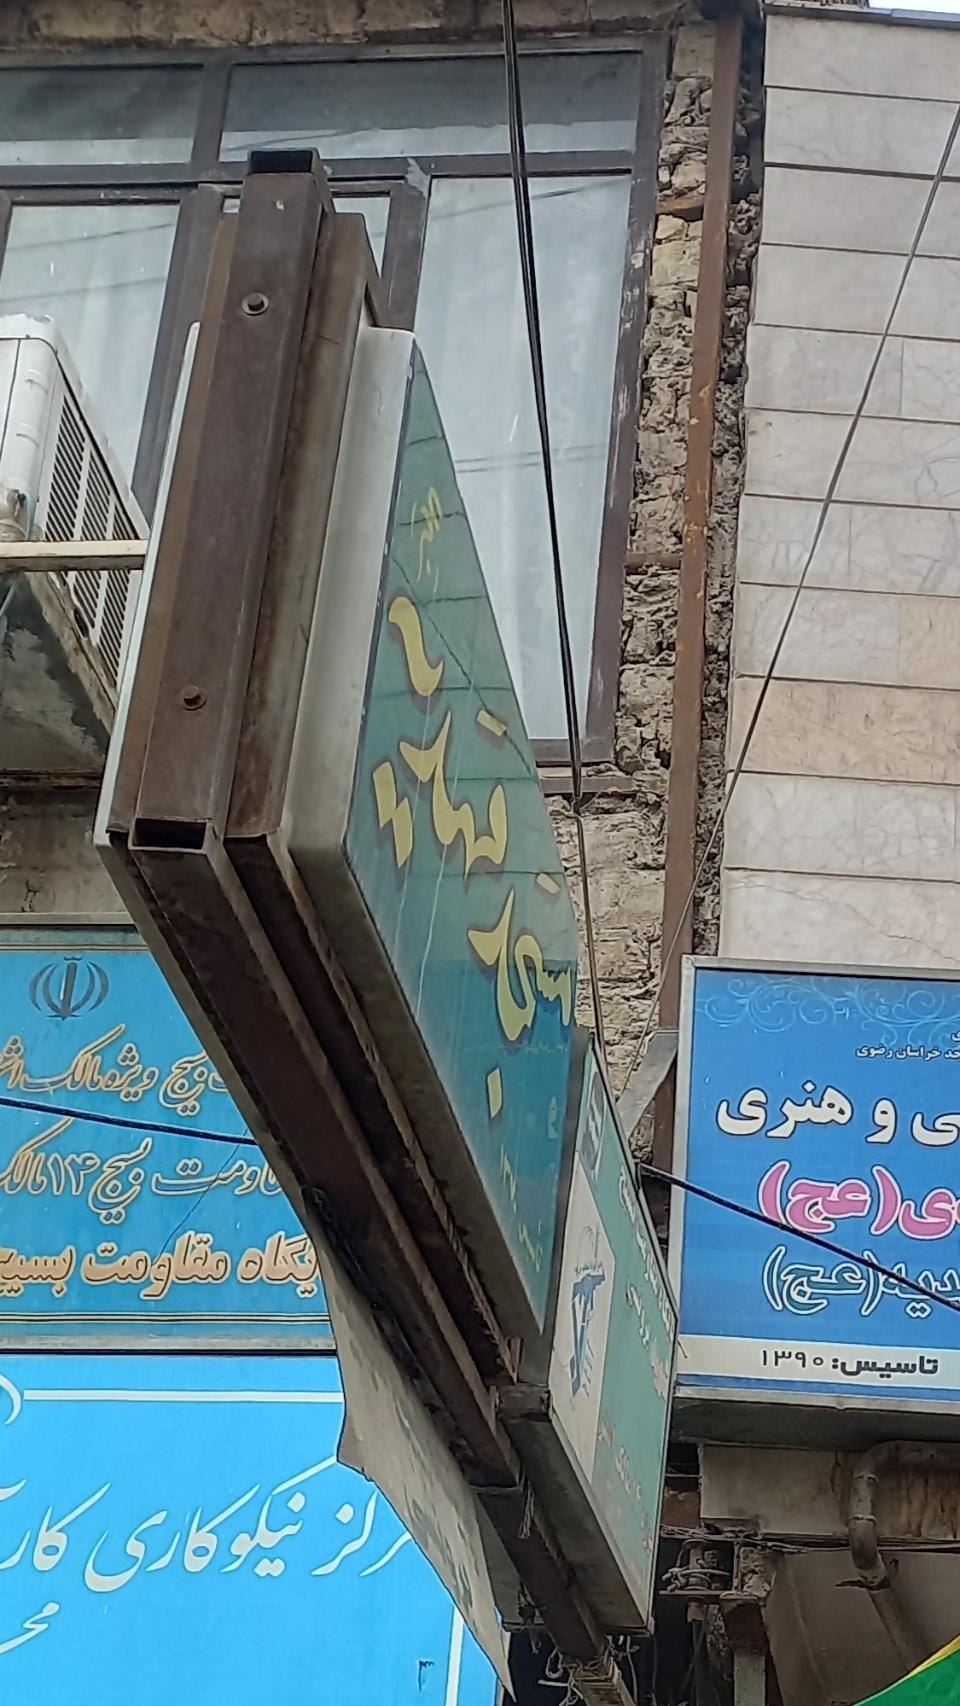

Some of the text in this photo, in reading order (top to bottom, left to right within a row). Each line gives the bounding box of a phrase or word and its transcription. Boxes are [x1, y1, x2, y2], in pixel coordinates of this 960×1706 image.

[22, 1023, 126, 1092] مالک
[100, 1042, 159, 1102] ویژه
[856, 1043, 893, 1058] رضوی
[895, 1046, 941, 1061] خراسان
[716, 1080, 854, 1138] هنری
[865, 1098, 898, 1143] و
[88, 1137, 153, 1224] بسیج
[81, 1231, 231, 1300] مقاومت
[761, 1348, 939, 1379] تاسیس: ۱۳۹۰
[84, 1455, 338, 1593] نیکوکاری
